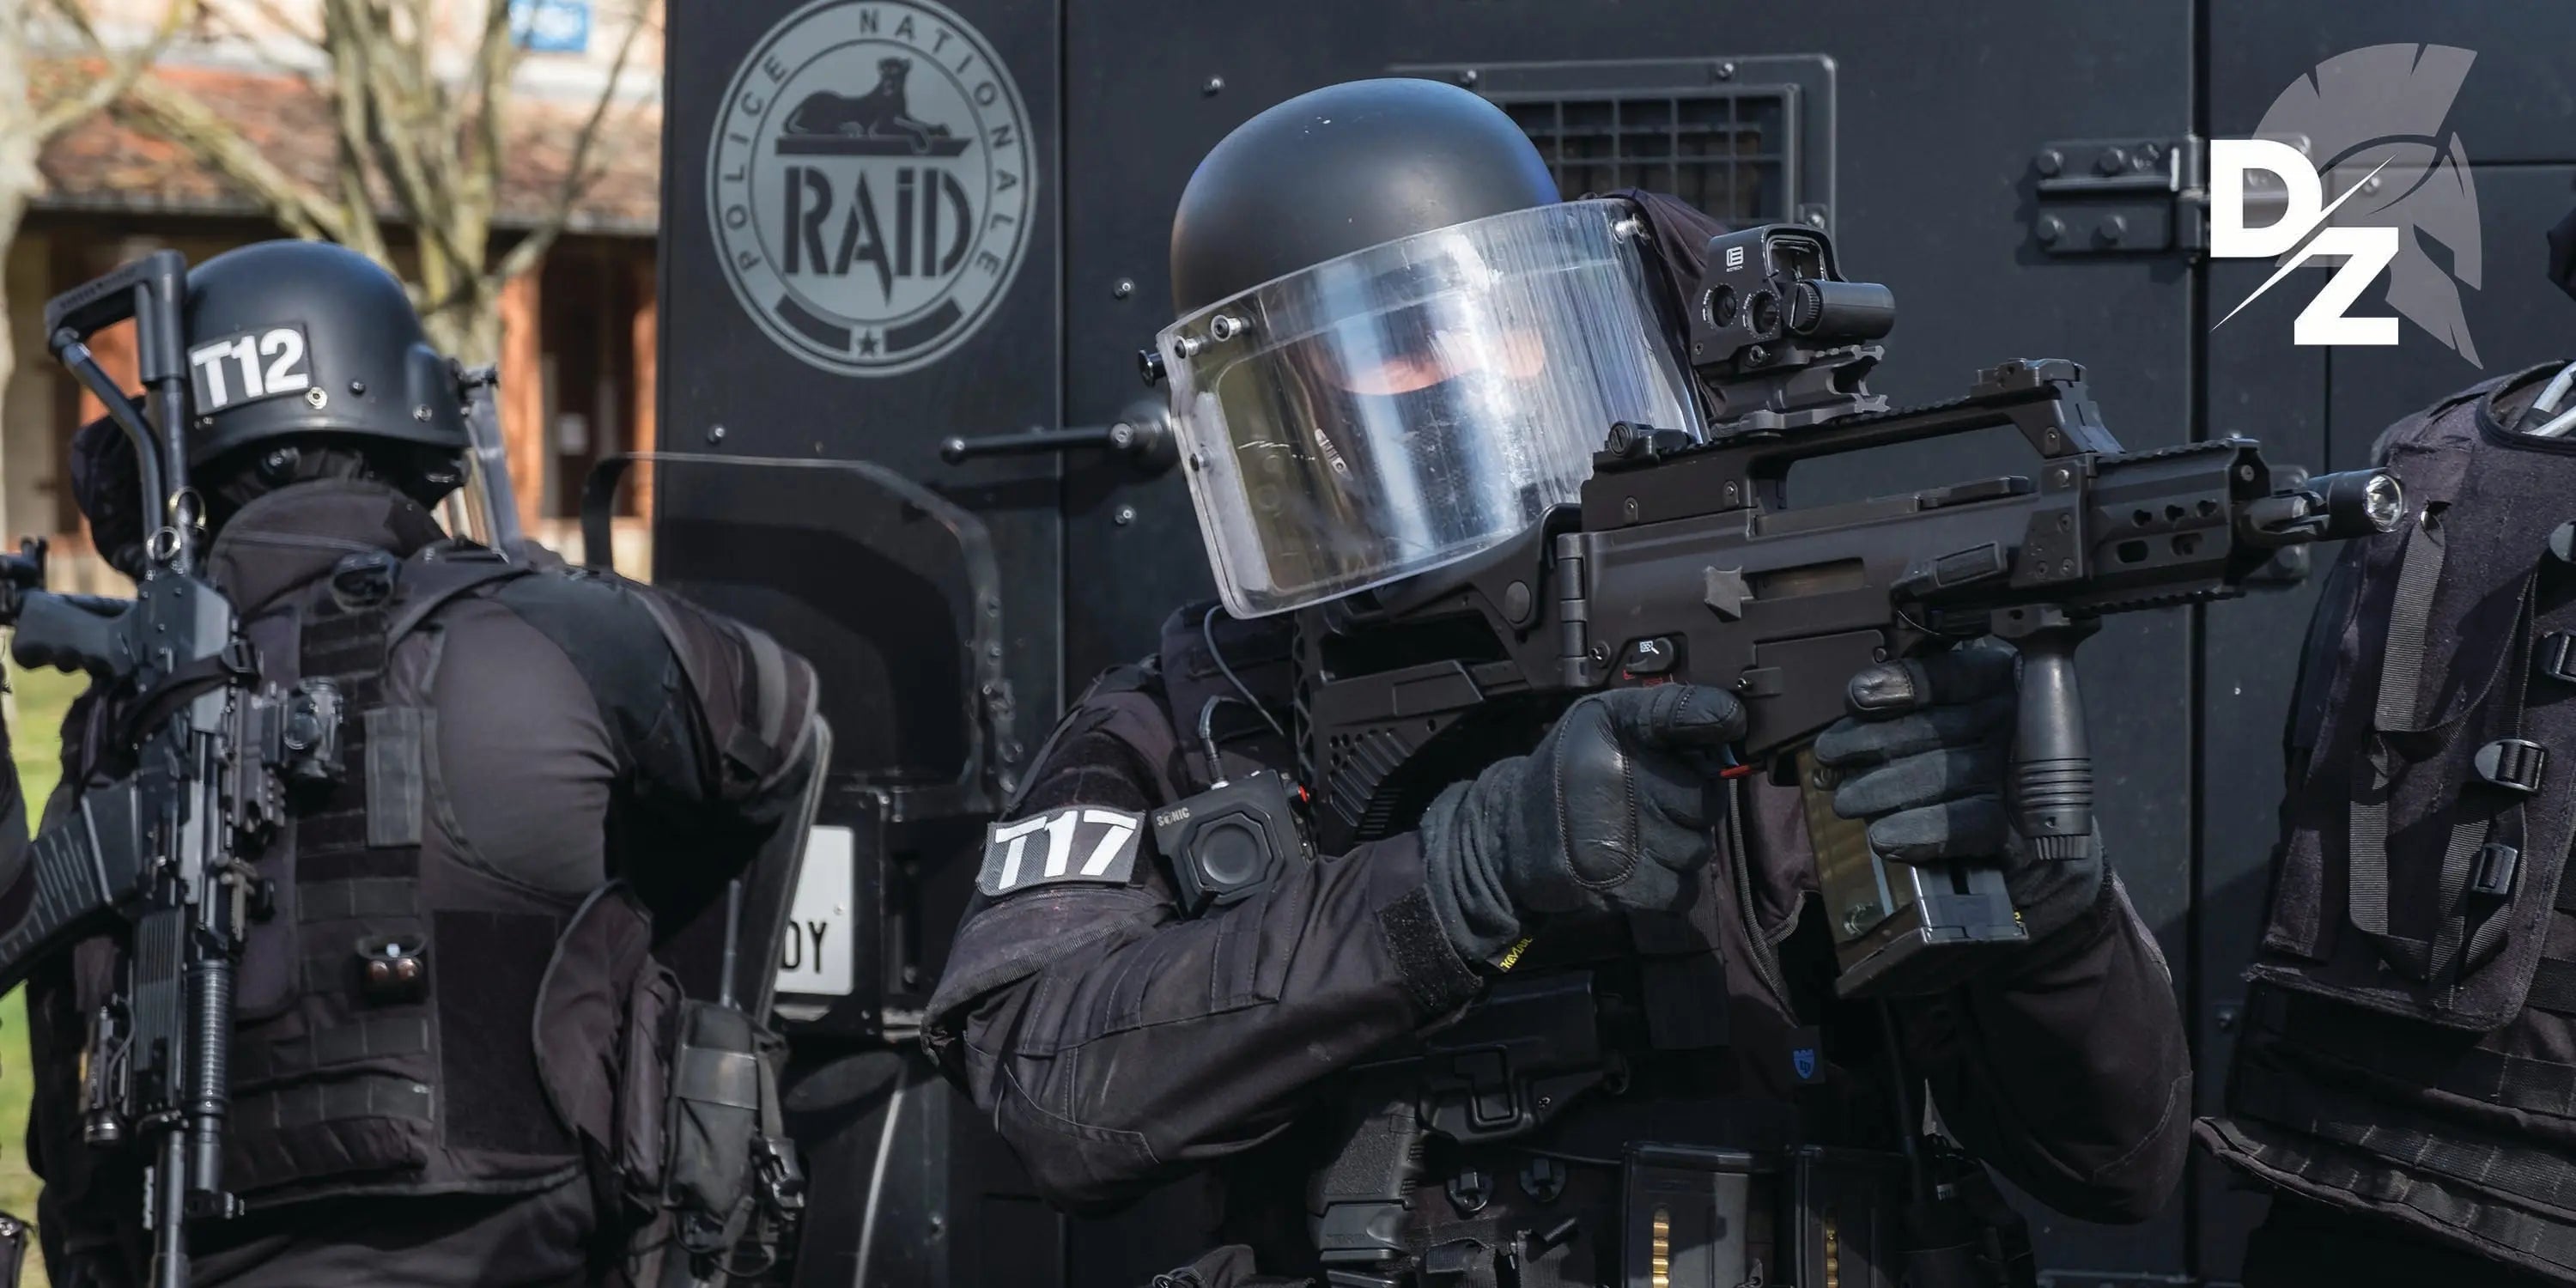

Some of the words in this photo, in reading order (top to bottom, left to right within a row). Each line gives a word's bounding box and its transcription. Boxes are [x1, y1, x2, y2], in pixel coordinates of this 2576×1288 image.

[723, 55, 788, 272] POLICE
[859, 7, 1018, 277] NATIONALE
[191, 328, 309, 408] T12
[994, 810, 1138, 890] T17
